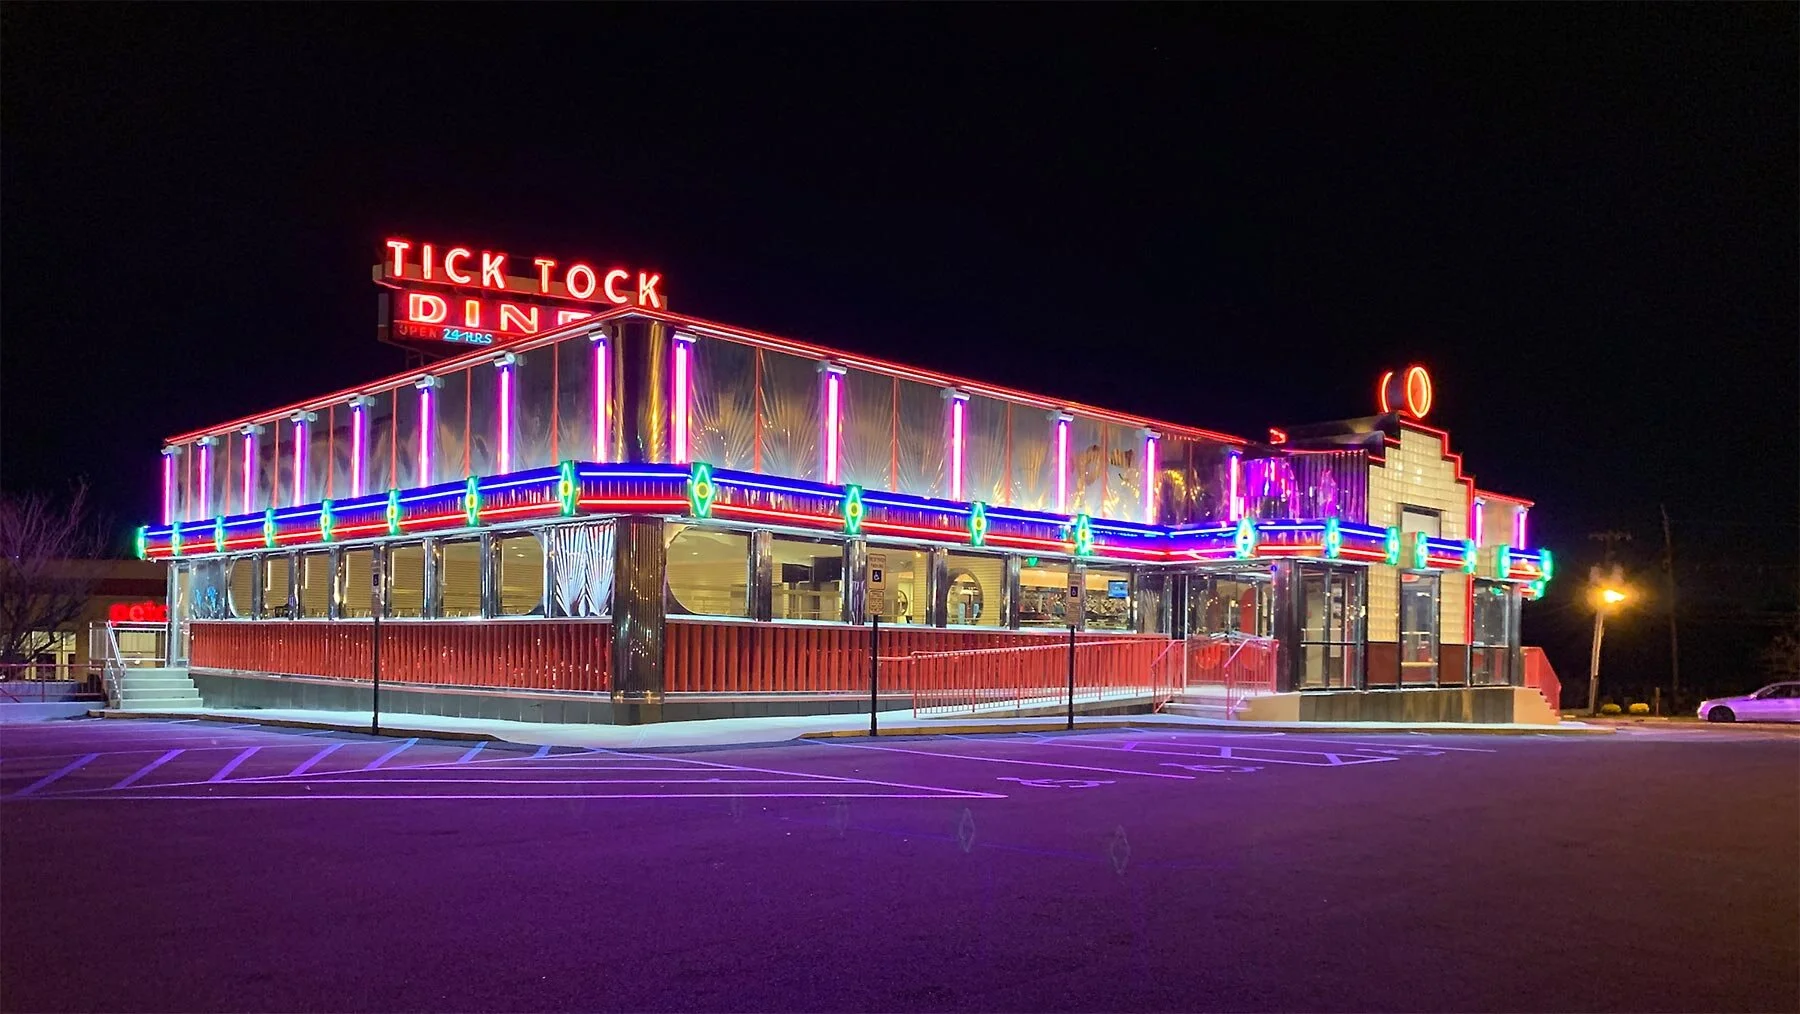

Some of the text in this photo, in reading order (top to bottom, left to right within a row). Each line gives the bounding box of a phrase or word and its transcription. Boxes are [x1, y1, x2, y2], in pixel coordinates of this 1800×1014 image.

[386, 240, 661, 309] TICK TOCK
[399, 325, 437, 339] OPEN
